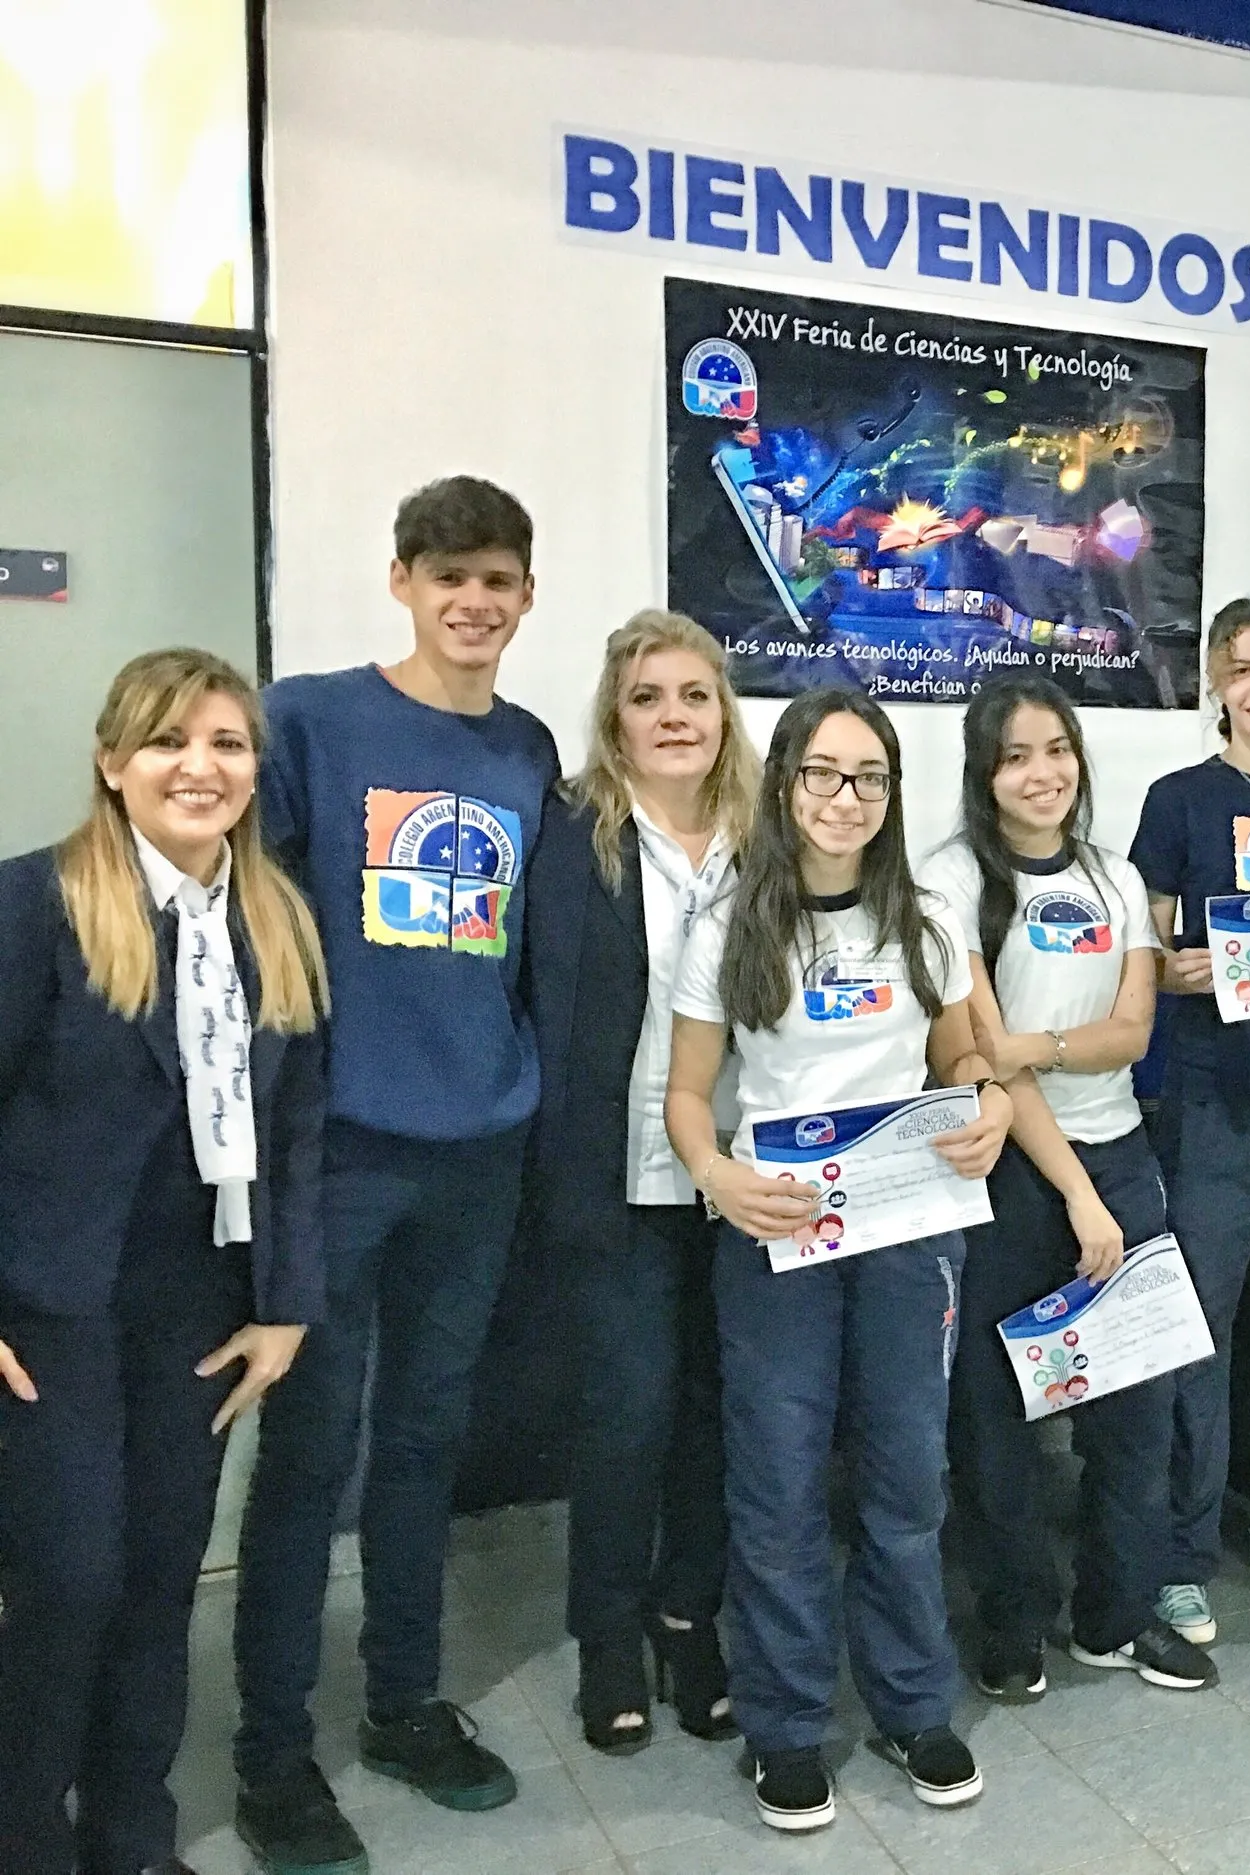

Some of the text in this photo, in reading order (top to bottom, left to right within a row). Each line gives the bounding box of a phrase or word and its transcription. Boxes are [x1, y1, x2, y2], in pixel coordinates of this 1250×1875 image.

[726, 306, 1134, 391] XXIV Feria de Ciencias y Tecnología
[725, 635, 1140, 676] Los avances tecnológicos. ¿Ayudan o perjudican?
[868, 671, 967, 696] ¿Benefician
[398, 821, 424, 865] COLEGIO
[486, 820, 512, 882] AMERICANO
